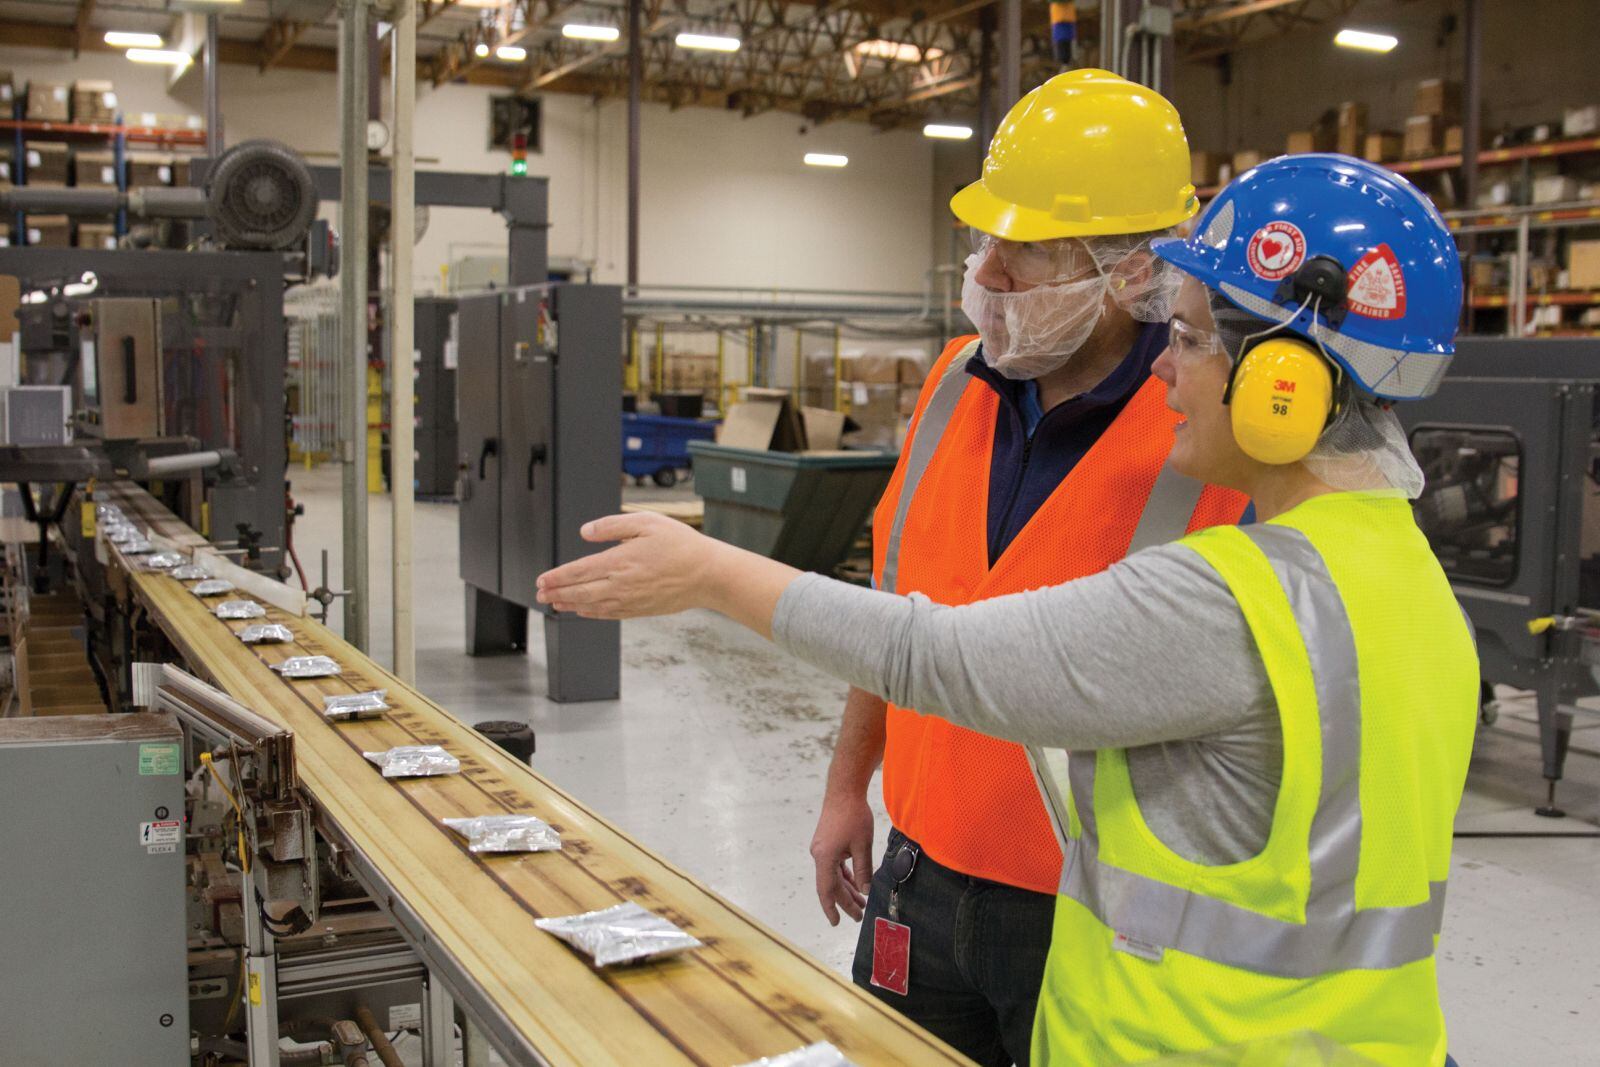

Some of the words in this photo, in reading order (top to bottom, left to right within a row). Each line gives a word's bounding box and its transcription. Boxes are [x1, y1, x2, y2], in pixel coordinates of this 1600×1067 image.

[1274, 224, 1297, 235] FIRST
[1295, 237, 1303, 253] AID
[1348, 260, 1369, 281] FIRE
[1389, 262, 1405, 297] SAFETY
[1350, 302, 1390, 318] TRAINED
[1273, 379, 1296, 392] 3M
[1272, 403, 1288, 416] 98
